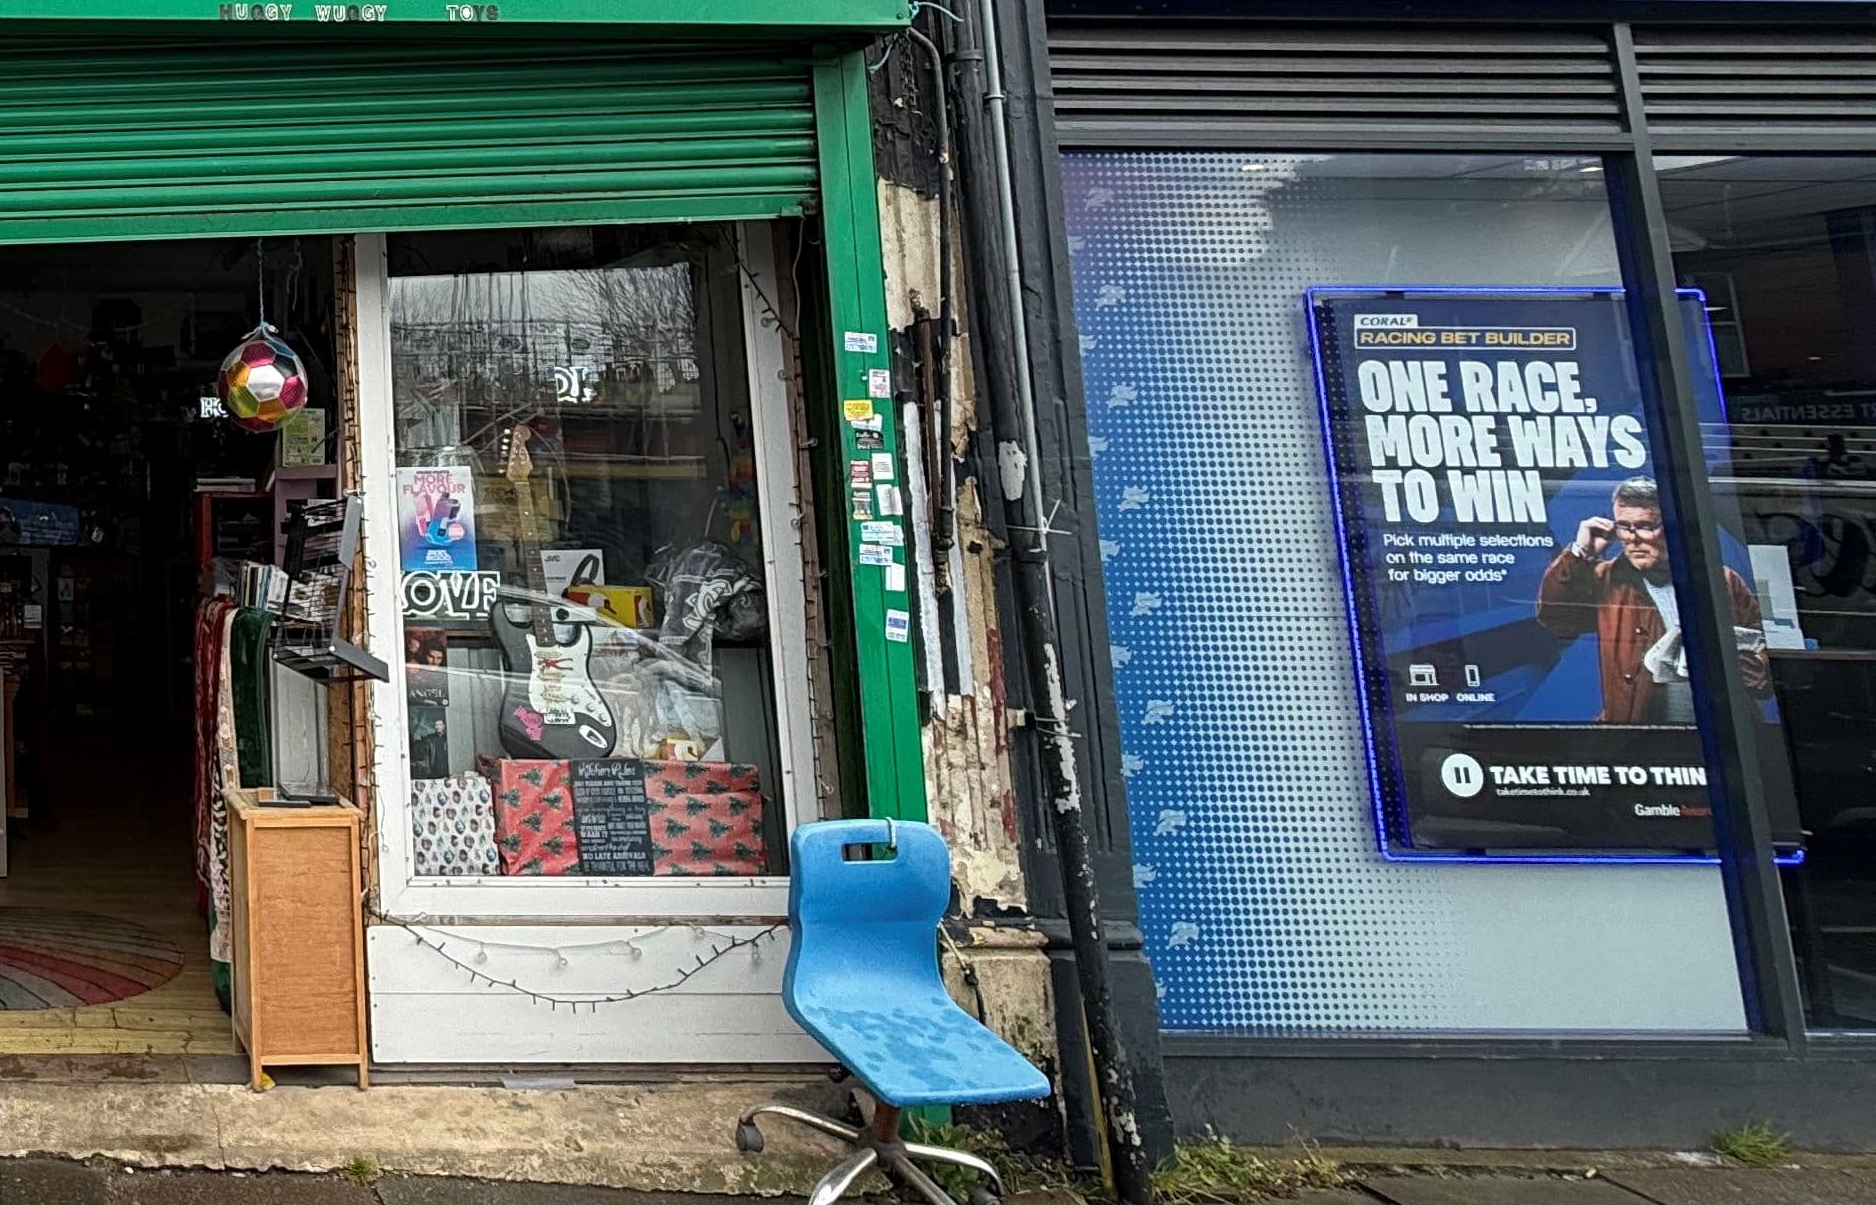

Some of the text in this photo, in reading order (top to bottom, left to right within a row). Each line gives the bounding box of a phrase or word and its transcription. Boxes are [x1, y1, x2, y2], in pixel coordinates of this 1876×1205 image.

[219, 3, 501, 22] HUGGY WUGGY TOYS
[1360, 331, 1571, 346] RACING BET BUILDER
[1357, 360, 1598, 414] ONE RACE,
[1365, 414, 1646, 469] MORE WAYS
[403, 483, 466, 495] FLAVOUR
[1371, 469, 1547, 524] TO WIN
[1383, 534, 1554, 550] Pick multiple selections
[1386, 552, 1515, 565] on the same race
[1387, 570, 1409, 582] for
[1414, 570, 1460, 584] bigger
[400, 570, 501, 620] OVE
[1420, 693, 1450, 702] SHOP
[1455, 693, 1496, 702] ONLINE
[1489, 766, 1551, 784] TAKE
[1553, 767, 1612, 785] TIME
[1613, 767, 1647, 785] TO
